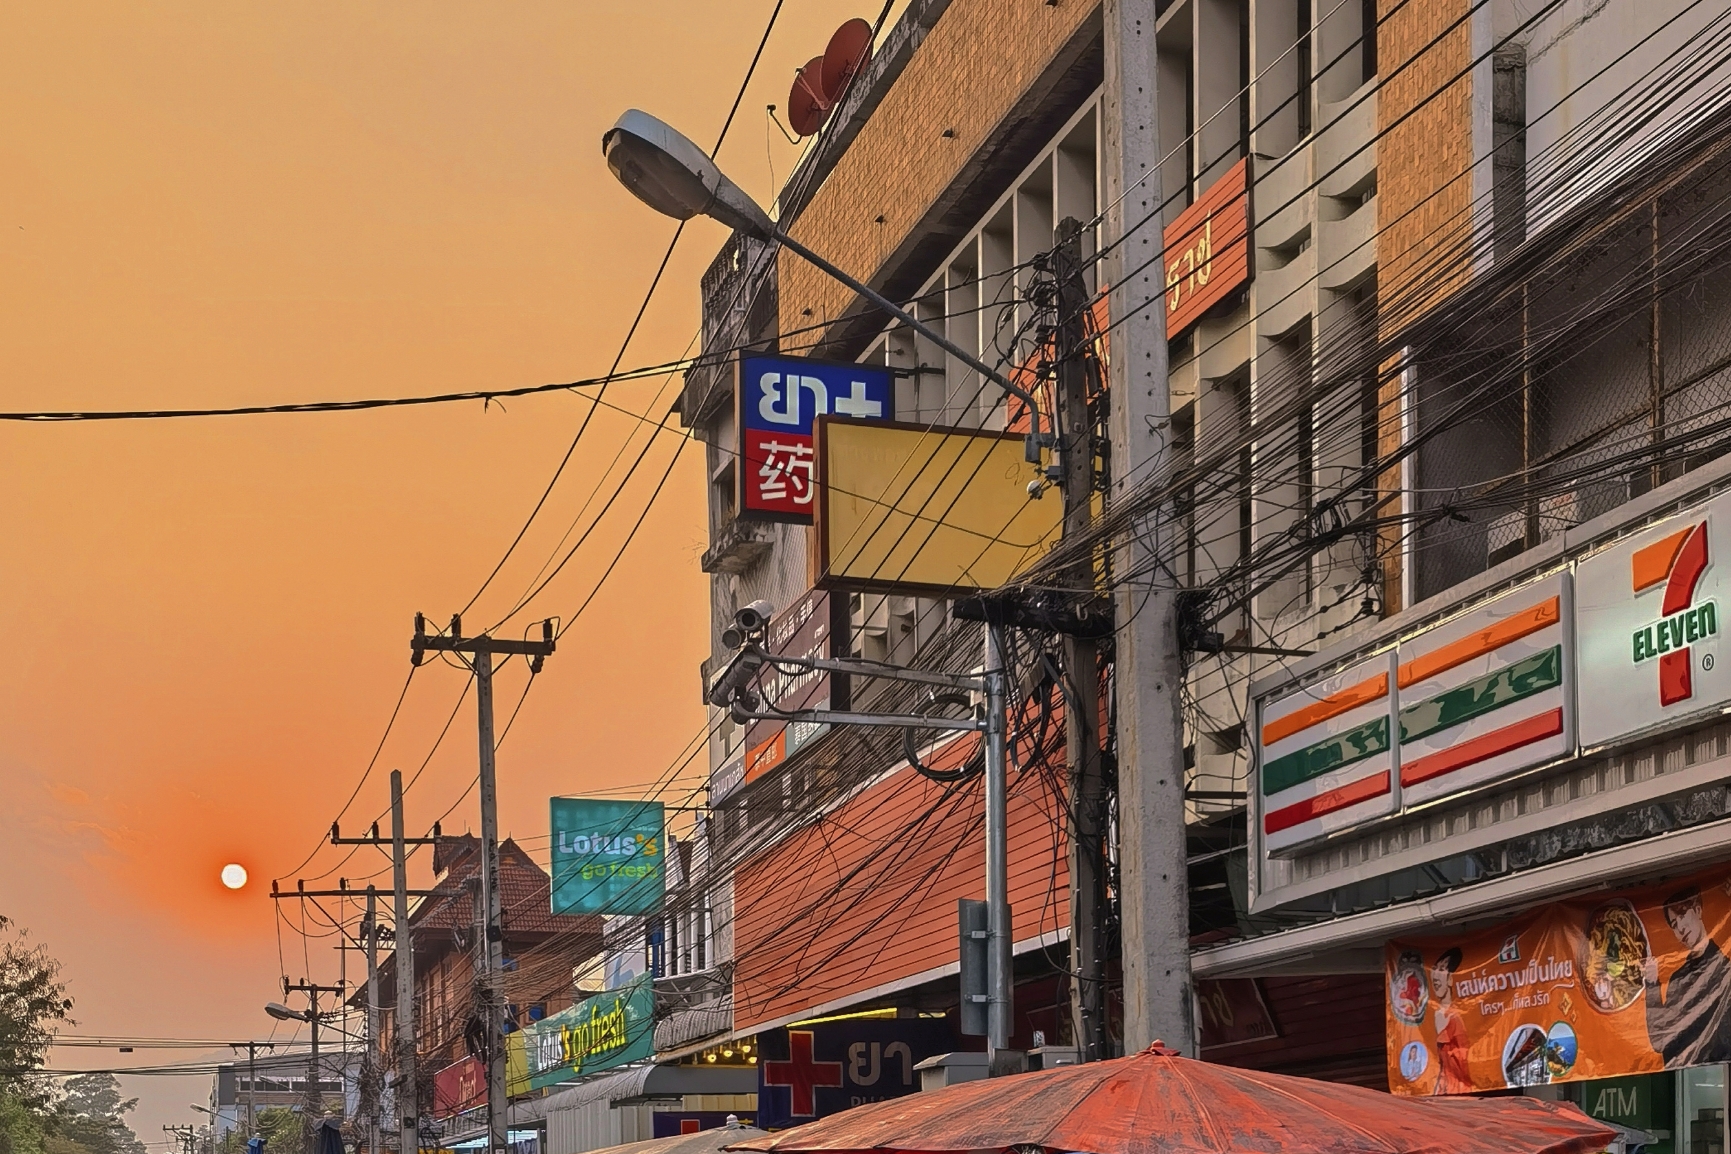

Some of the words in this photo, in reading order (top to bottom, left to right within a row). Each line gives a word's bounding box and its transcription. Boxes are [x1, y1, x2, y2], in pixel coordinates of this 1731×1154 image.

[759, 372, 827, 425] ยา
[759, 440, 813, 504] 药
[559, 831, 658, 857] Lotus's
[581, 864, 606, 879] go
[610, 862, 658, 879] fresh
[848, 1041, 912, 1087] ยา
[1592, 1086, 1637, 1118] ATM
